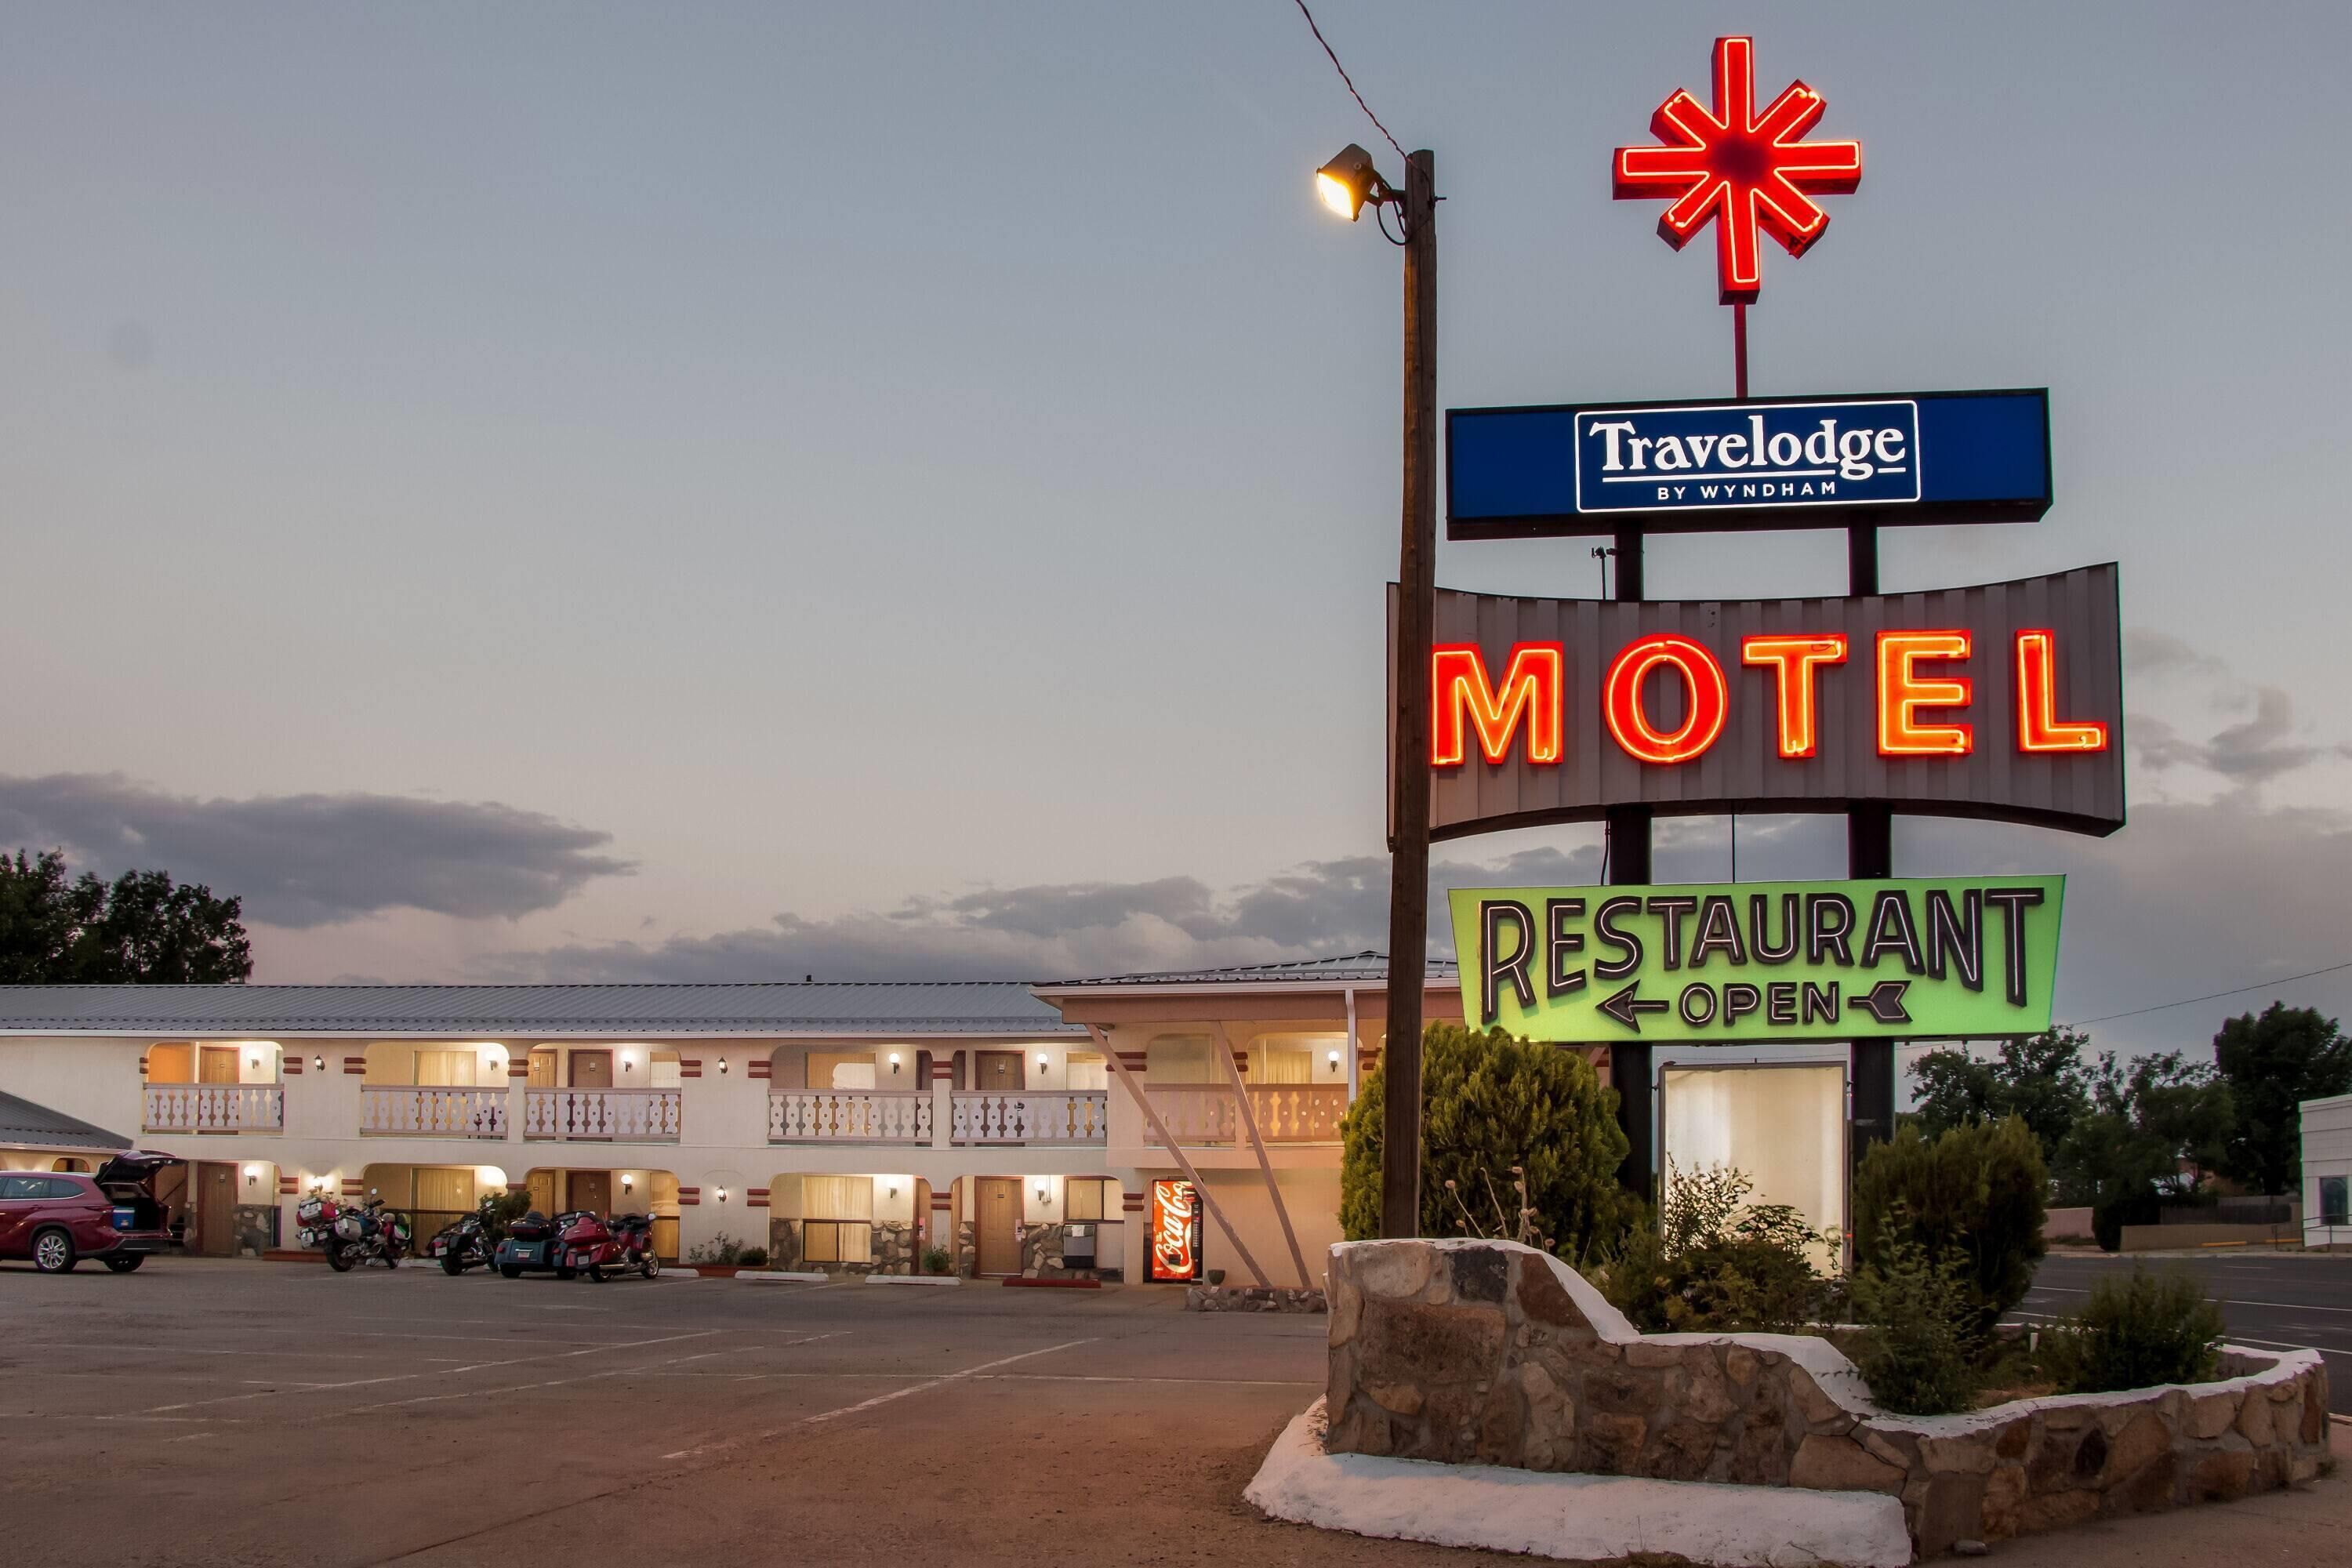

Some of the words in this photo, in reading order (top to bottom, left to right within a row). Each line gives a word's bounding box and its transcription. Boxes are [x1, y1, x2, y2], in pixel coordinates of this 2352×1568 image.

[1589, 415, 1906, 480] Travelodge
[1657, 486, 1686, 500] BY
[1700, 481, 1836, 499] WYNDHAM
[1431, 630, 2107, 765] MOTEL
[1479, 887, 2045, 1025] RESTAURANT
[1678, 981, 1839, 1027] OPEN
